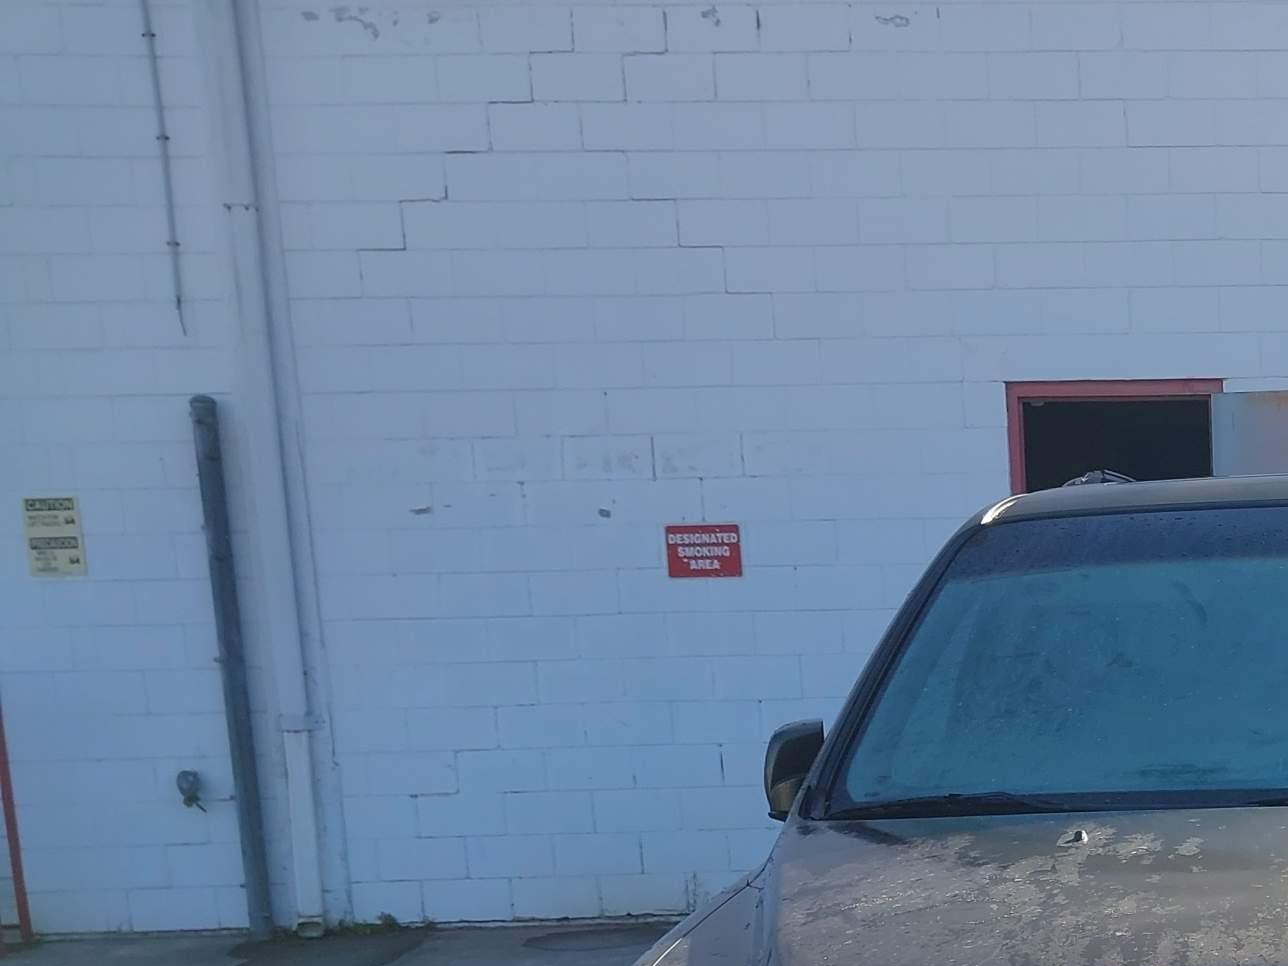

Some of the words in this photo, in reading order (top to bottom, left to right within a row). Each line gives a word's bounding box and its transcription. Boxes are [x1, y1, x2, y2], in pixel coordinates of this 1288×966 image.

[668, 533, 738, 544] DESIGNATED
[677, 546, 730, 557] SMOKING
[689, 559, 720, 569] AREA
